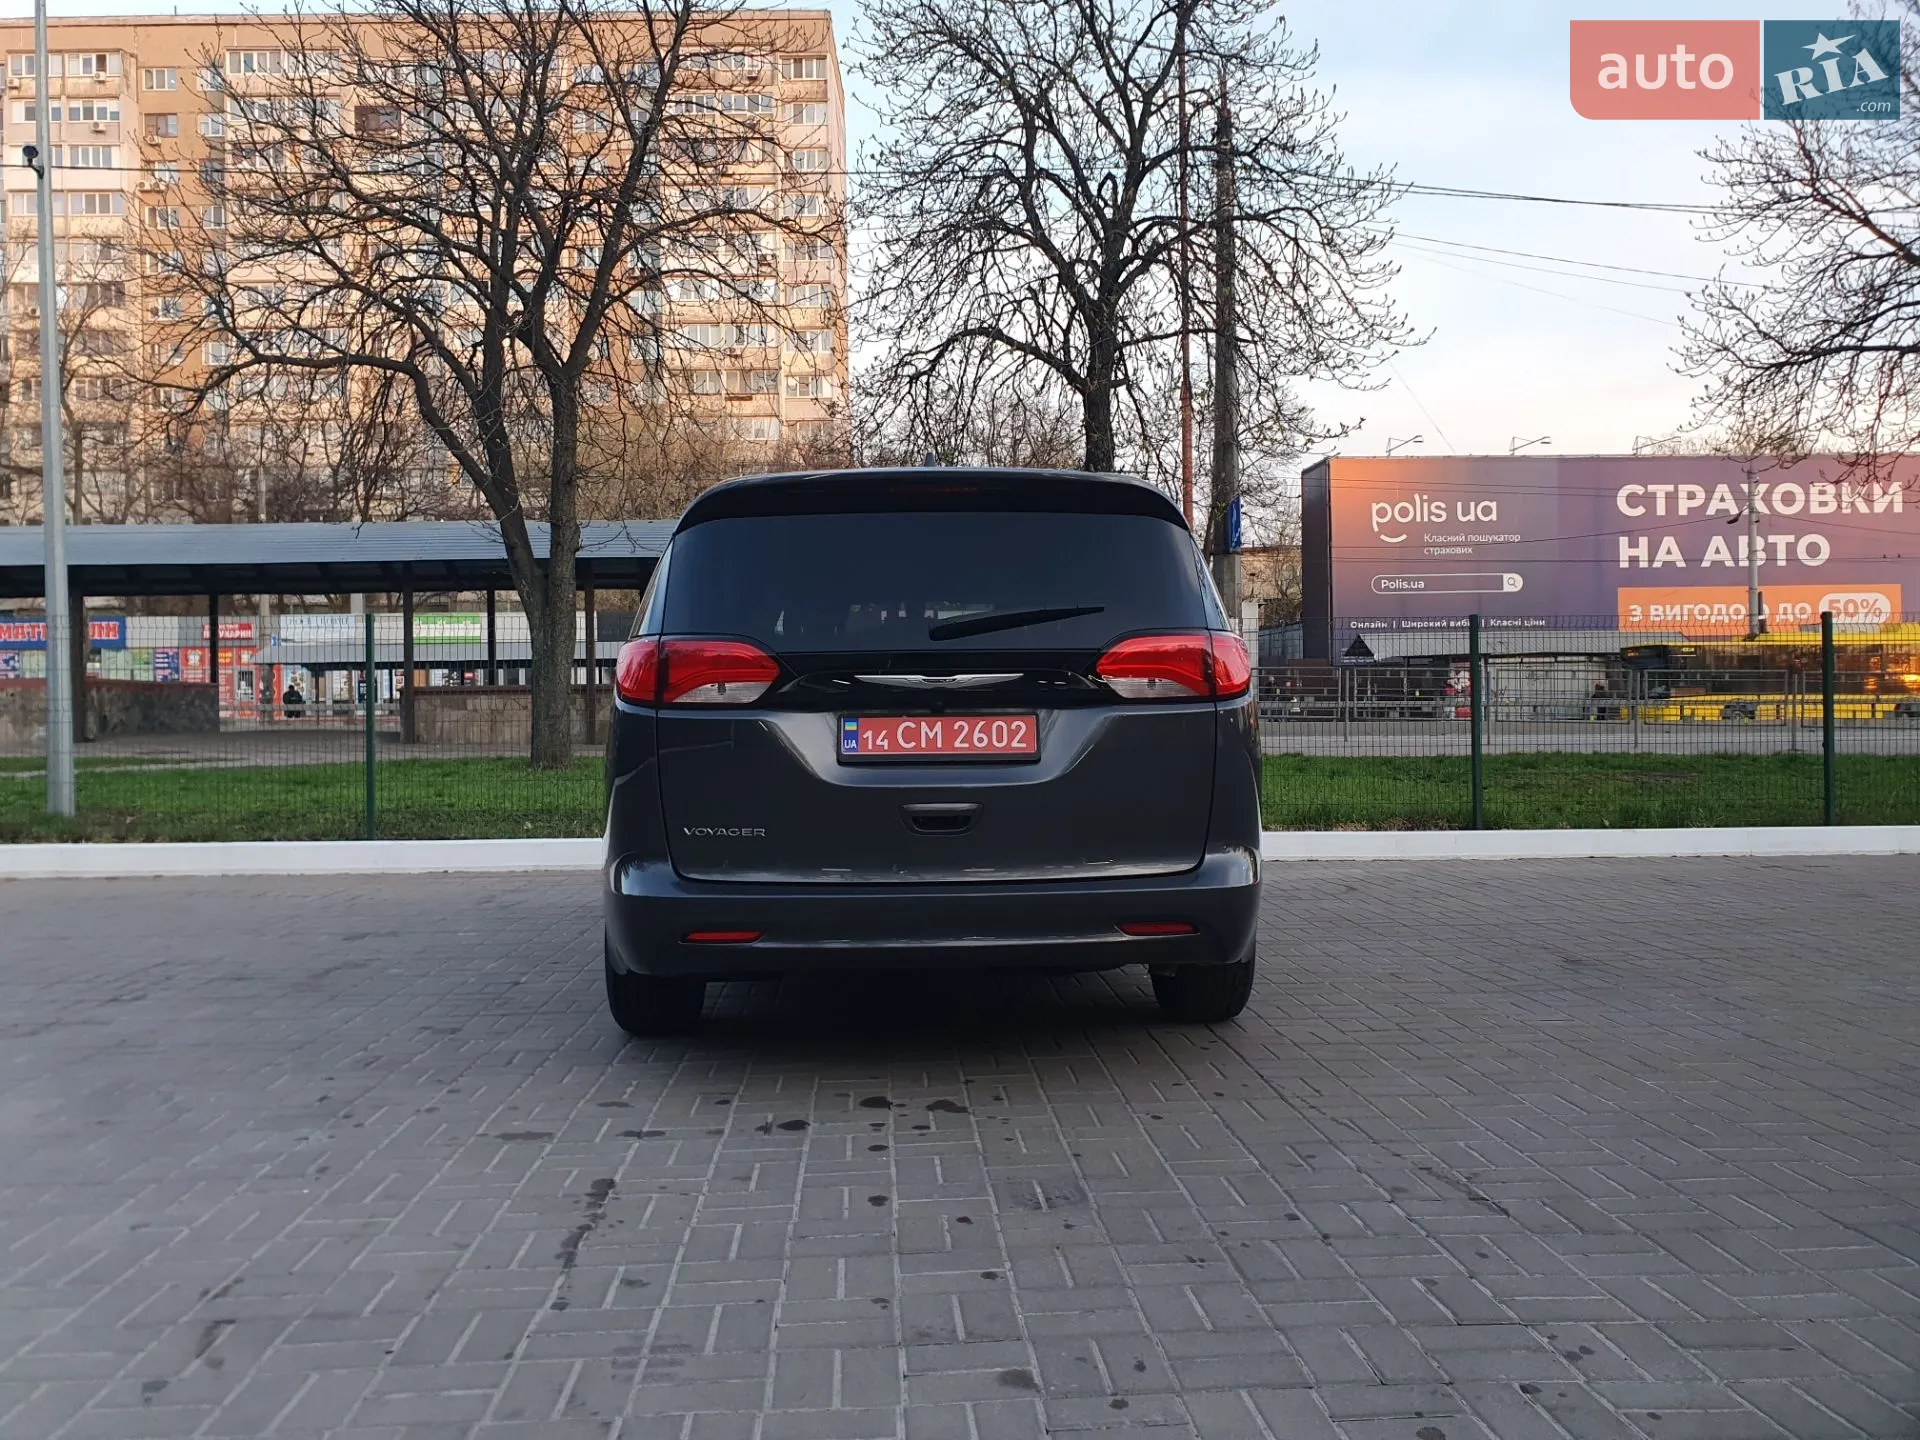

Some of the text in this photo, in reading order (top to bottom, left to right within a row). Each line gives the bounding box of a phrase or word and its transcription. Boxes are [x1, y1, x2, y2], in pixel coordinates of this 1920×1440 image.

[1616, 481, 1903, 517] СТРАХОВКИ
[1371, 493, 1497, 532] polis ua
[1424, 533, 1521, 544] Класний пошукатор
[1424, 546, 1473, 556] страхових
[1619, 533, 1831, 569] НА АВТО
[1381, 579, 1425, 589] Polis.ua
[1776, 602, 1812, 623] ДО
[1827, 598, 1883, 619] 50%
[1350, 618, 1546, 629] Онлайн Широкий вибі Класні ціни
[862, 720, 1027, 750] 14 CM 2602
[844, 739, 857, 749] UA
[683, 827, 766, 837] VOYAGER
